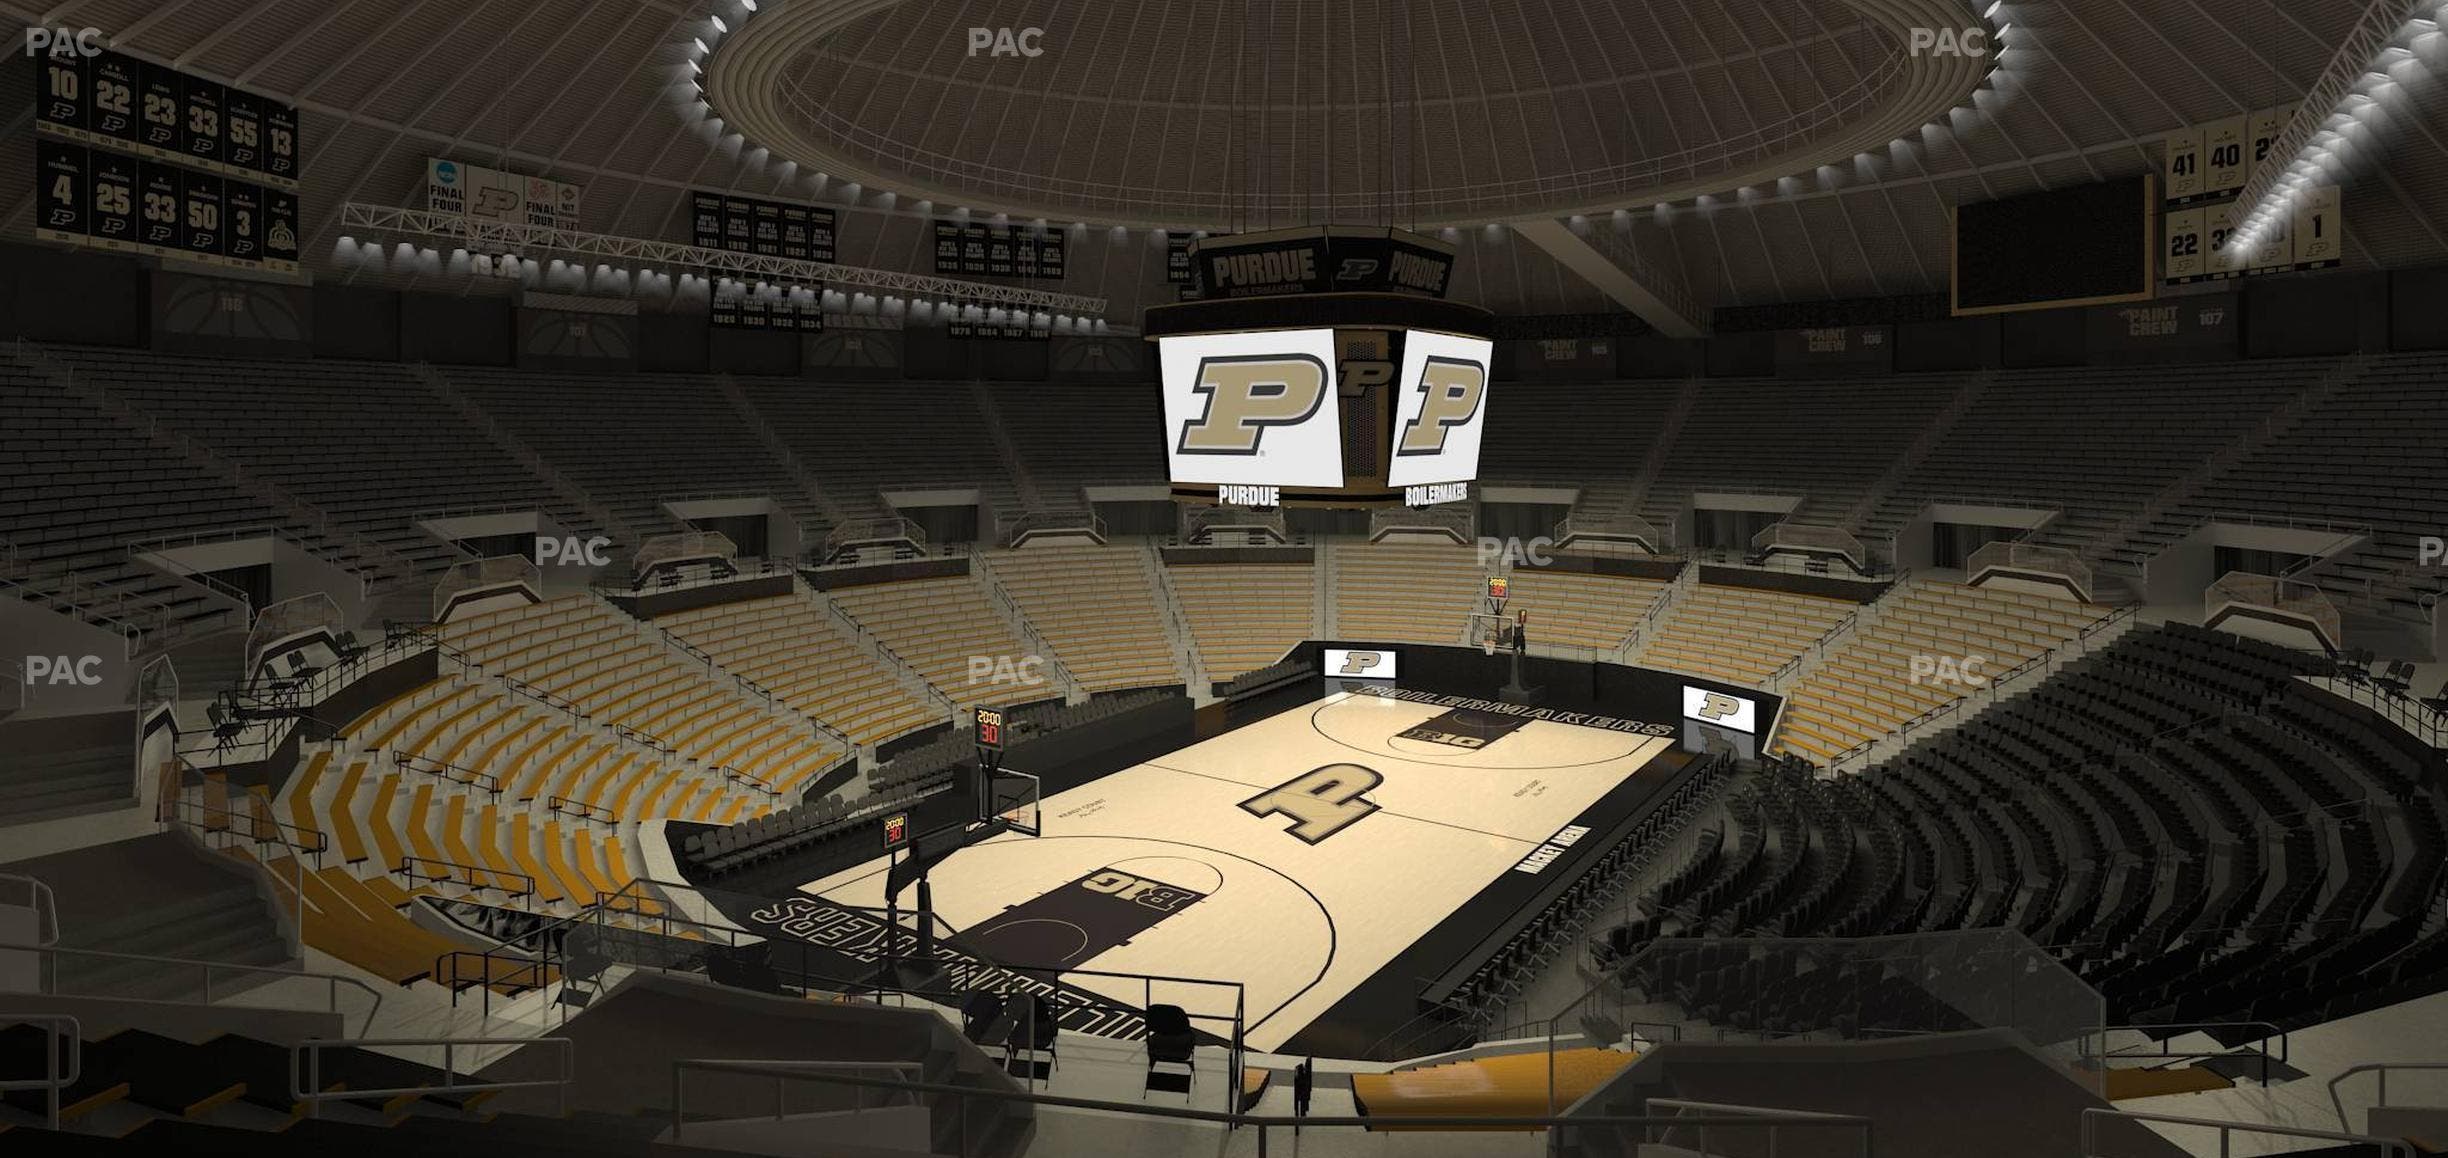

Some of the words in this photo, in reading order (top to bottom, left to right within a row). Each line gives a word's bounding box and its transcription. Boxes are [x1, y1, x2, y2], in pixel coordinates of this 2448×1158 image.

[48, 66, 79, 101] 10
[96, 79, 131, 116] 22
[49, 101, 76, 119] P
[144, 93, 177, 127] 23
[188, 105, 218, 137] 33
[101, 114, 127, 132] P
[230, 116, 258, 147] 55
[149, 127, 172, 143] P
[192, 138, 214, 153] P
[270, 128, 293, 156] 13
[233, 148, 255, 163] P
[271, 158, 291, 172] P
[2172, 153, 2195, 176] 41
[2211, 144, 2240, 168] 40
[51, 174, 73, 206] 4
[96, 182, 131, 215] 25
[430, 184, 465, 201] FINAL
[49, 207, 76, 226] P
[144, 192, 177, 223] 33
[188, 200, 218, 231] 50
[431, 197, 463, 213] FOUR
[526, 201, 556, 216] FINAL
[101, 216, 127, 234] P
[149, 224, 172, 240] P
[236, 210, 251, 236] 3
[527, 214, 554, 228] FOUR
[2312, 214, 2321, 238] 1
[192, 232, 214, 248] P
[233, 239, 255, 254] P
[2171, 232, 2198, 257] 22
[1212, 247, 1316, 287] PURDUE
[1336, 258, 1379, 281] P
[1388, 248, 1448, 292] PURDUE
[2128, 306, 2178, 322] PAINT
[2199, 311, 2224, 326] 107
[2129, 320, 2178, 336] CREW
[1339, 359, 1395, 398] P
[1176, 353, 1329, 456] P
[1397, 355, 1485, 458] P
[1218, 485, 1280, 507] PURDUE
[1405, 482, 1467, 507] BOILERMAKERS
[1339, 651, 1381, 674] P
[1357, 683, 1675, 737] BOILERMAKERS
[1697, 691, 1740, 721] P
[977, 709, 1001, 727] 20:00
[981, 724, 998, 744] 30
[1234, 762, 1385, 846] P
[886, 816, 905, 831] 20:00
[888, 826, 902, 843] 30
[1514, 843, 1566, 875] MACKEY
[1549, 824, 1592, 848] ARENA
[1081, 871, 1196, 912] BIG
